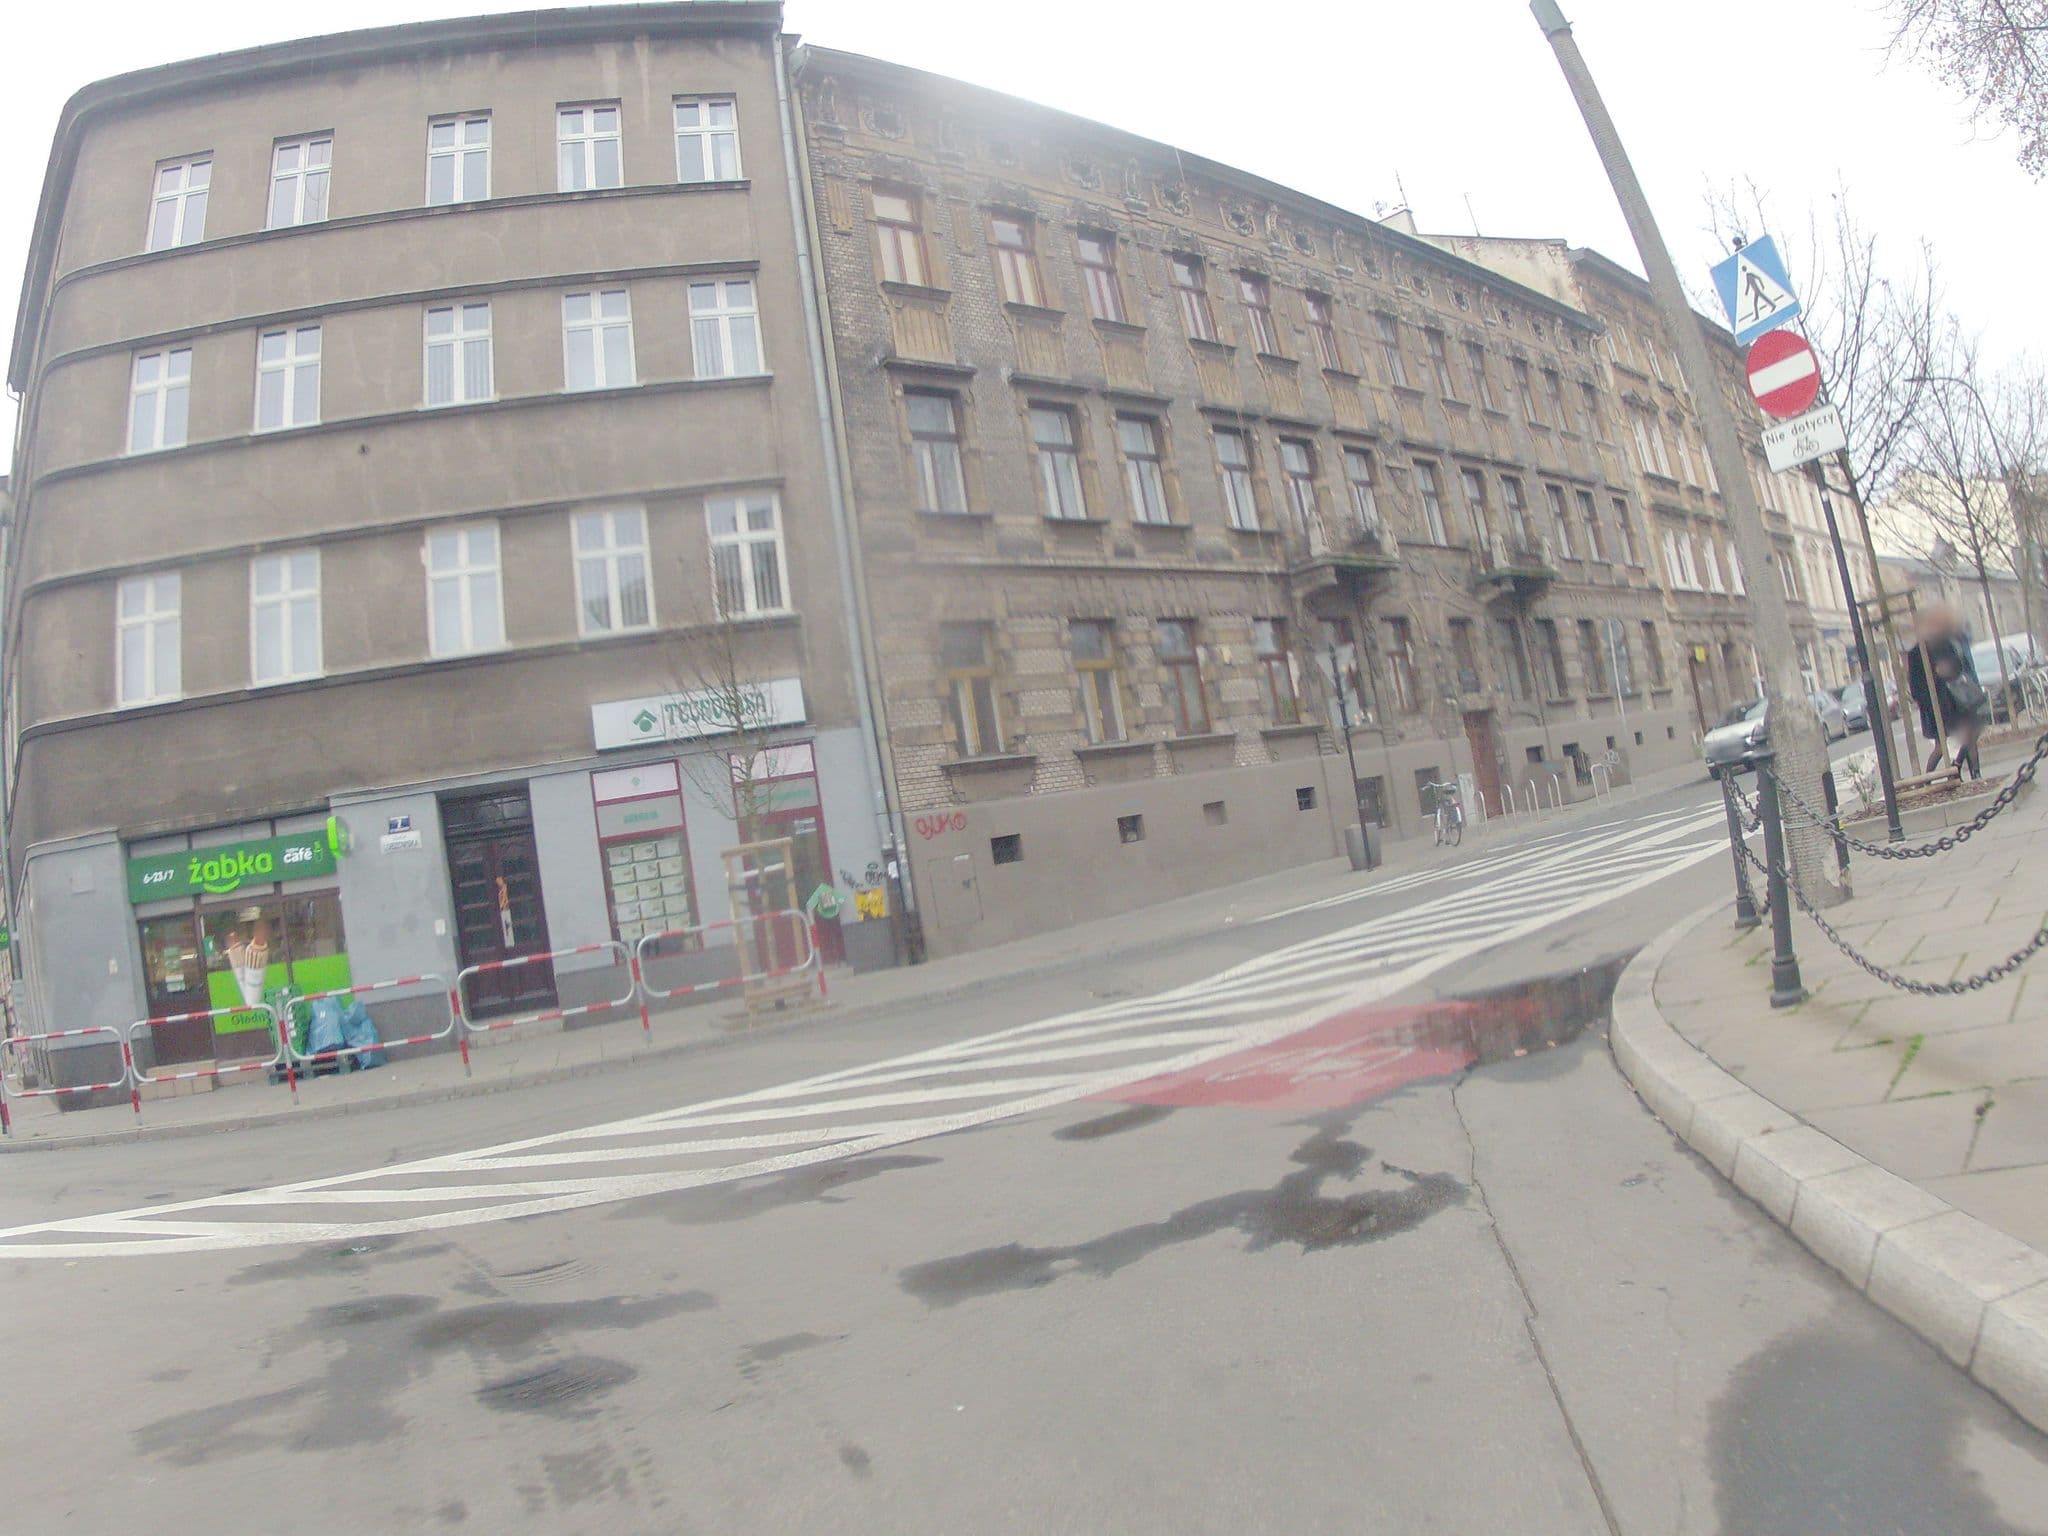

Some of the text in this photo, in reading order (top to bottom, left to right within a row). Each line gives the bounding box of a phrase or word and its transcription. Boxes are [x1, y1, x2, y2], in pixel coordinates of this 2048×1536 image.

[1766, 413, 1834, 446] Nie dotyczy
[187, 850, 273, 885] żabka
[283, 847, 313, 864] café
